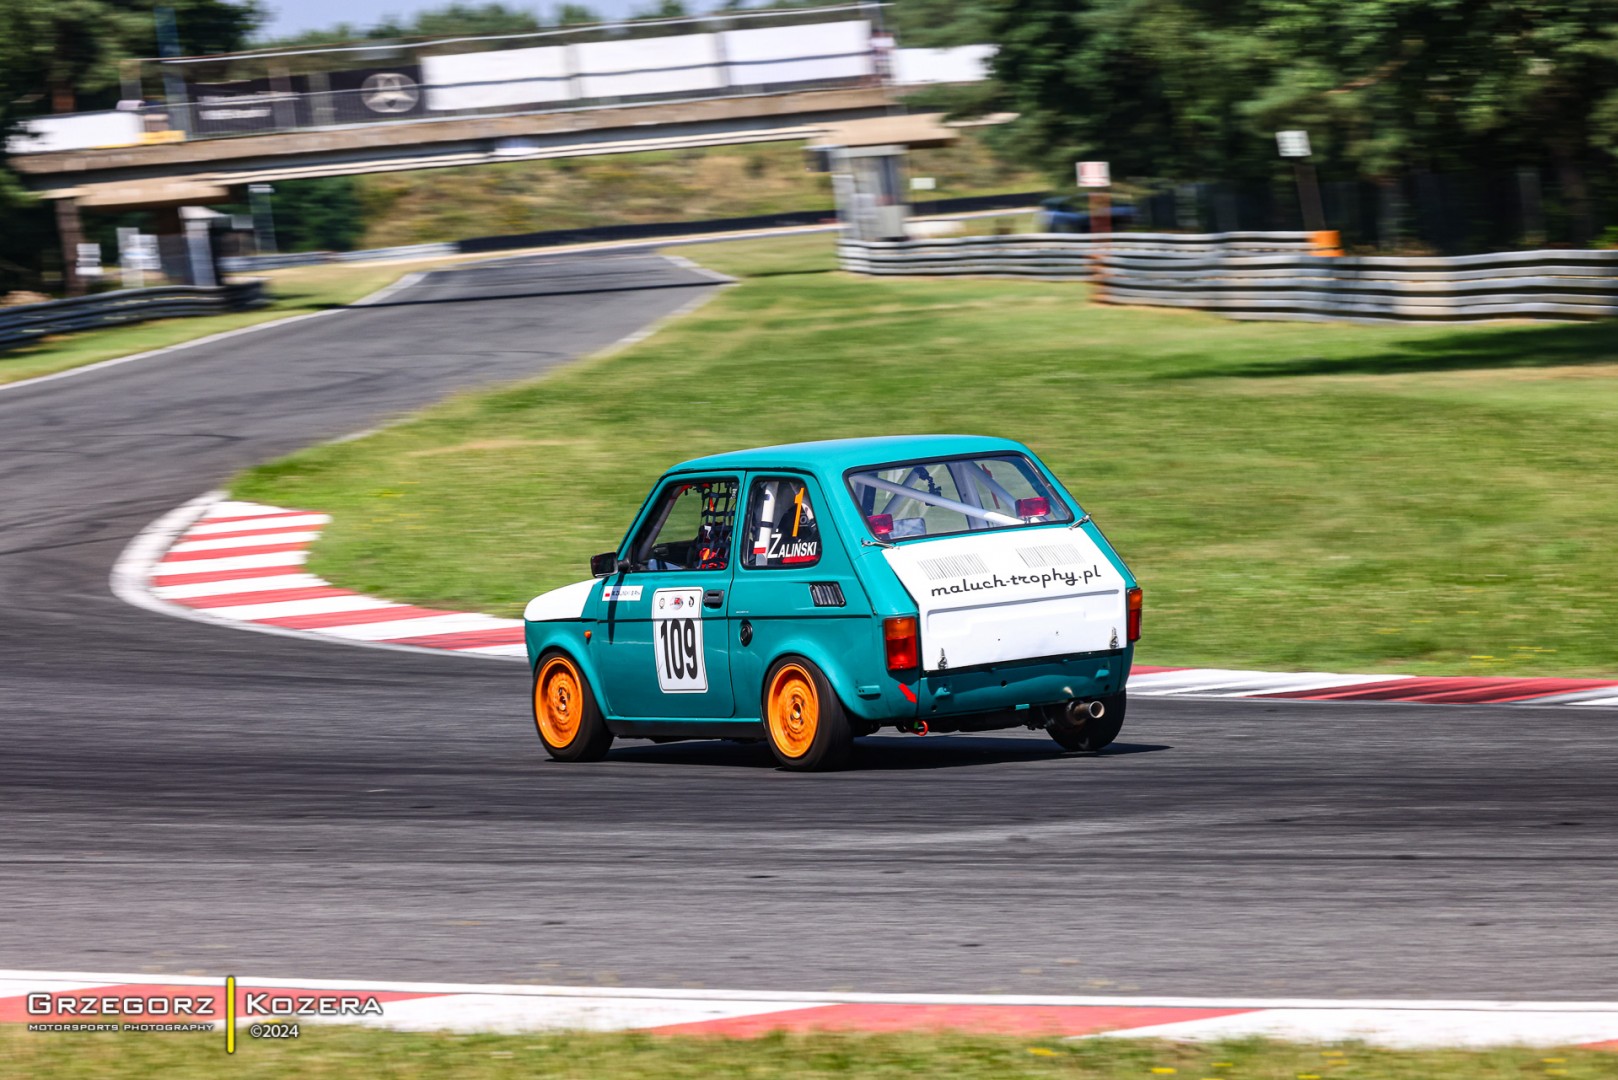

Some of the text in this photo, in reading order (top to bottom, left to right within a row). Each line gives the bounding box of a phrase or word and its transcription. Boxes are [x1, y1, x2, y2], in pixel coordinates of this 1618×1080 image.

[767, 528, 818, 558] ŻALIŃSKI
[931, 564, 1102, 597] maluch-trophy.pl
[660, 618, 698, 680] 109
